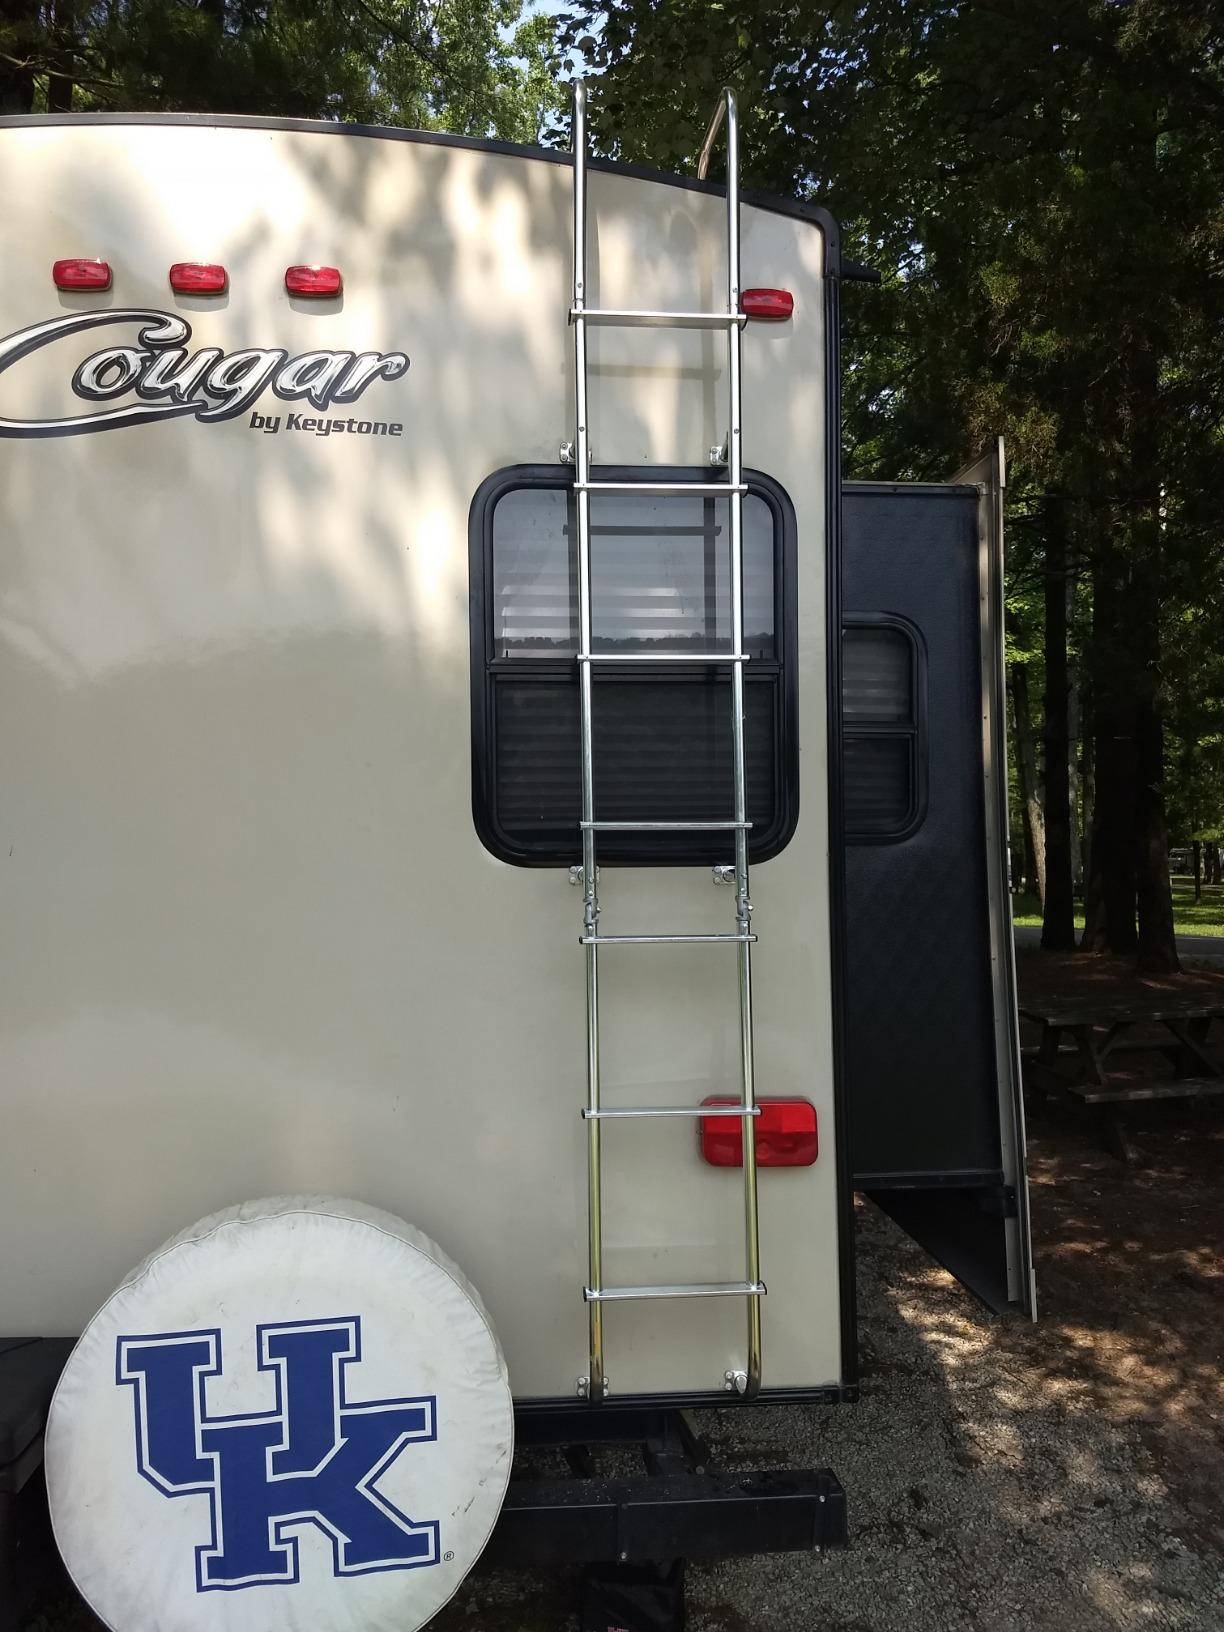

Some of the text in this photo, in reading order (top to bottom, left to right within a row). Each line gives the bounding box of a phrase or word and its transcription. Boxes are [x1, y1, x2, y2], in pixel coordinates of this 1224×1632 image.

[0, 308, 410, 438] Cougar
[249, 412, 403, 437] by Keystone
[115, 1315, 441, 1593] UK
